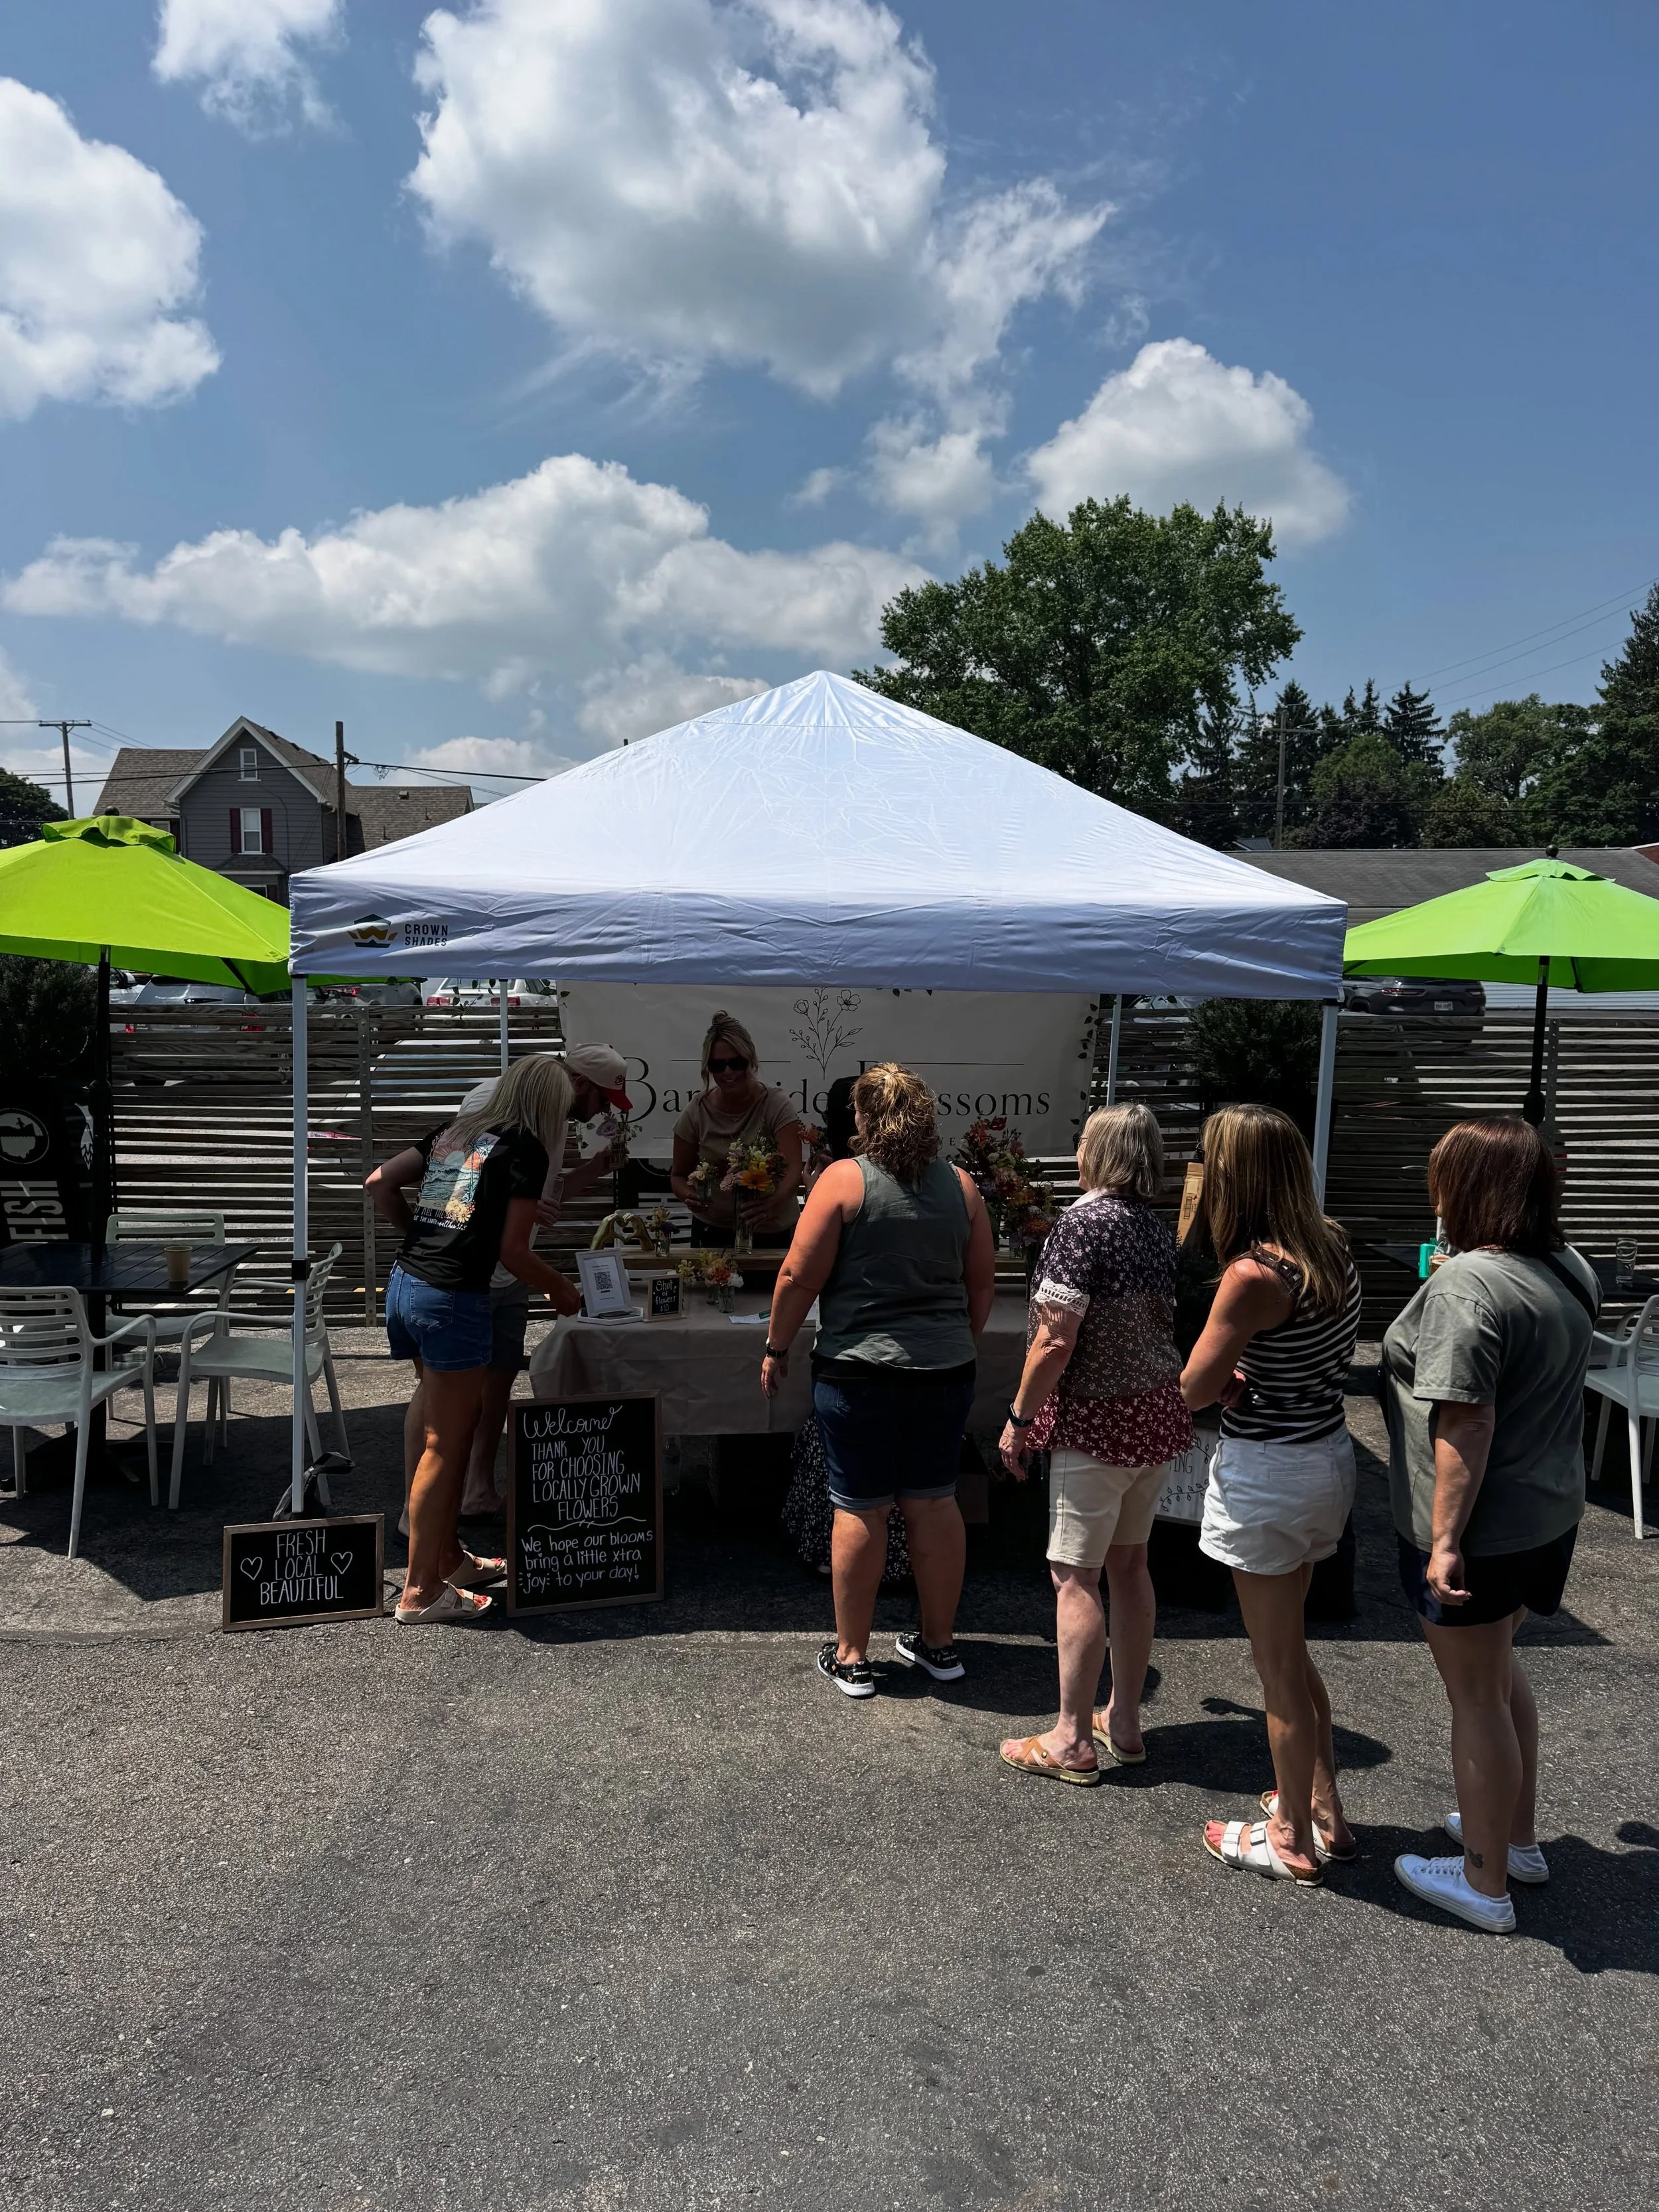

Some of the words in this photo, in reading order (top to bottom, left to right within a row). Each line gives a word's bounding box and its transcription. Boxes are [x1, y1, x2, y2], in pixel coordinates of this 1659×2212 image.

[405, 924, 448, 936] CROWN
[405, 936, 447, 946] SHADES
[0, 1180, 69, 1240] FISH
[656, 1280, 674, 1291] Shot
[655, 1295, 676, 1305] flowers
[524, 1405, 623, 1439] Welcome
[532, 1440, 567, 1461] THANK
[581, 1434, 605, 1455] YOU
[532, 1461, 554, 1481] FOR
[560, 1450, 625, 1478] CHOOSING
[533, 1477, 587, 1503] LOCALLY
[590, 1473, 640, 1497] GROWN
[558, 1496, 618, 1520] FLOWERS
[277, 1528, 326, 1558] FRESH
[521, 1536, 541, 1552] We
[549, 1534, 579, 1553] hope
[584, 1534, 607, 1547] our
[610, 1530, 653, 1546] blooms
[275, 1555, 323, 1580] LOCAL
[525, 1553, 559, 1572] bring
[563, 1554, 573, 1566] a
[577, 1550, 607, 1565] little
[613, 1548, 642, 1562] xtra
[259, 1575, 344, 1605] BEAUTIFUL
[523, 1573, 546, 1593] joy
[555, 1571, 572, 1586] to
[575, 1570, 605, 1588] your
[609, 1564, 640, 1583] day!
